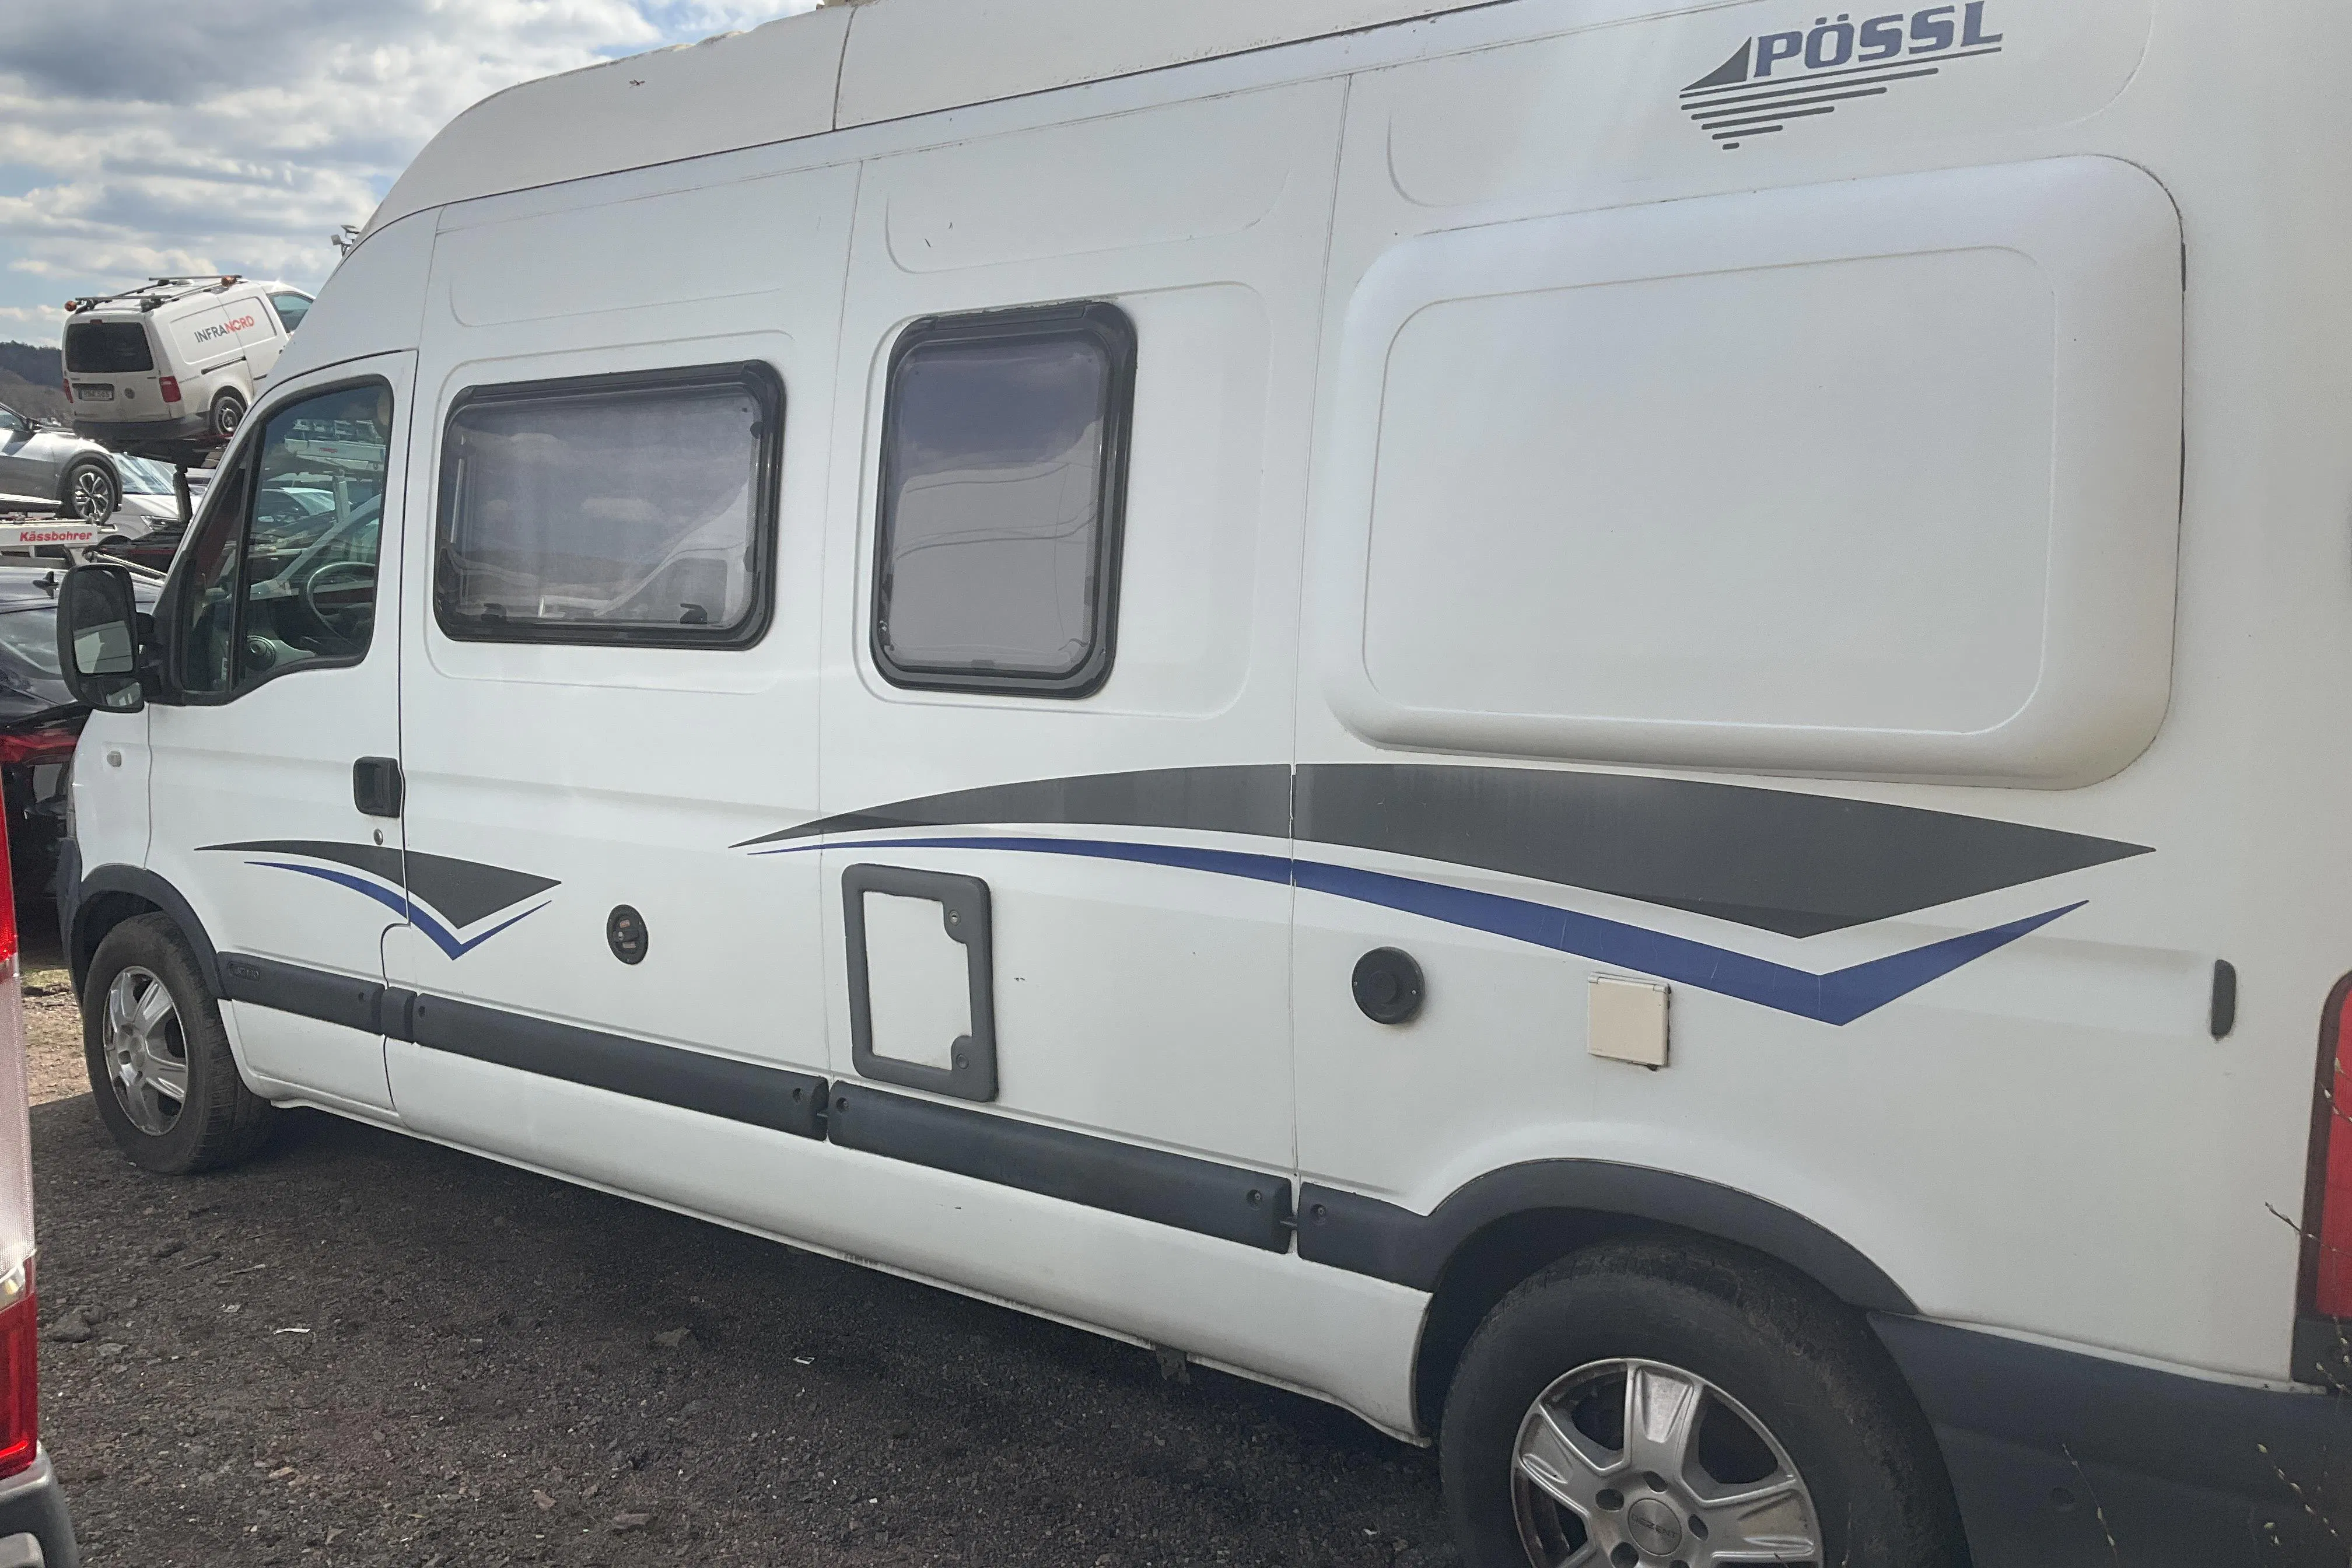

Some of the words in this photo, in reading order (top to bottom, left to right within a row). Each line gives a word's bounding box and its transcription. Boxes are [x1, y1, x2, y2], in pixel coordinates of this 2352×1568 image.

[1754, 0, 2003, 77] PÖSSL
[194, 315, 254, 343] INFRANORD
[19, 531, 92, 542] Kässbohrer
[1632, 1514, 1680, 1538] DEZENT
